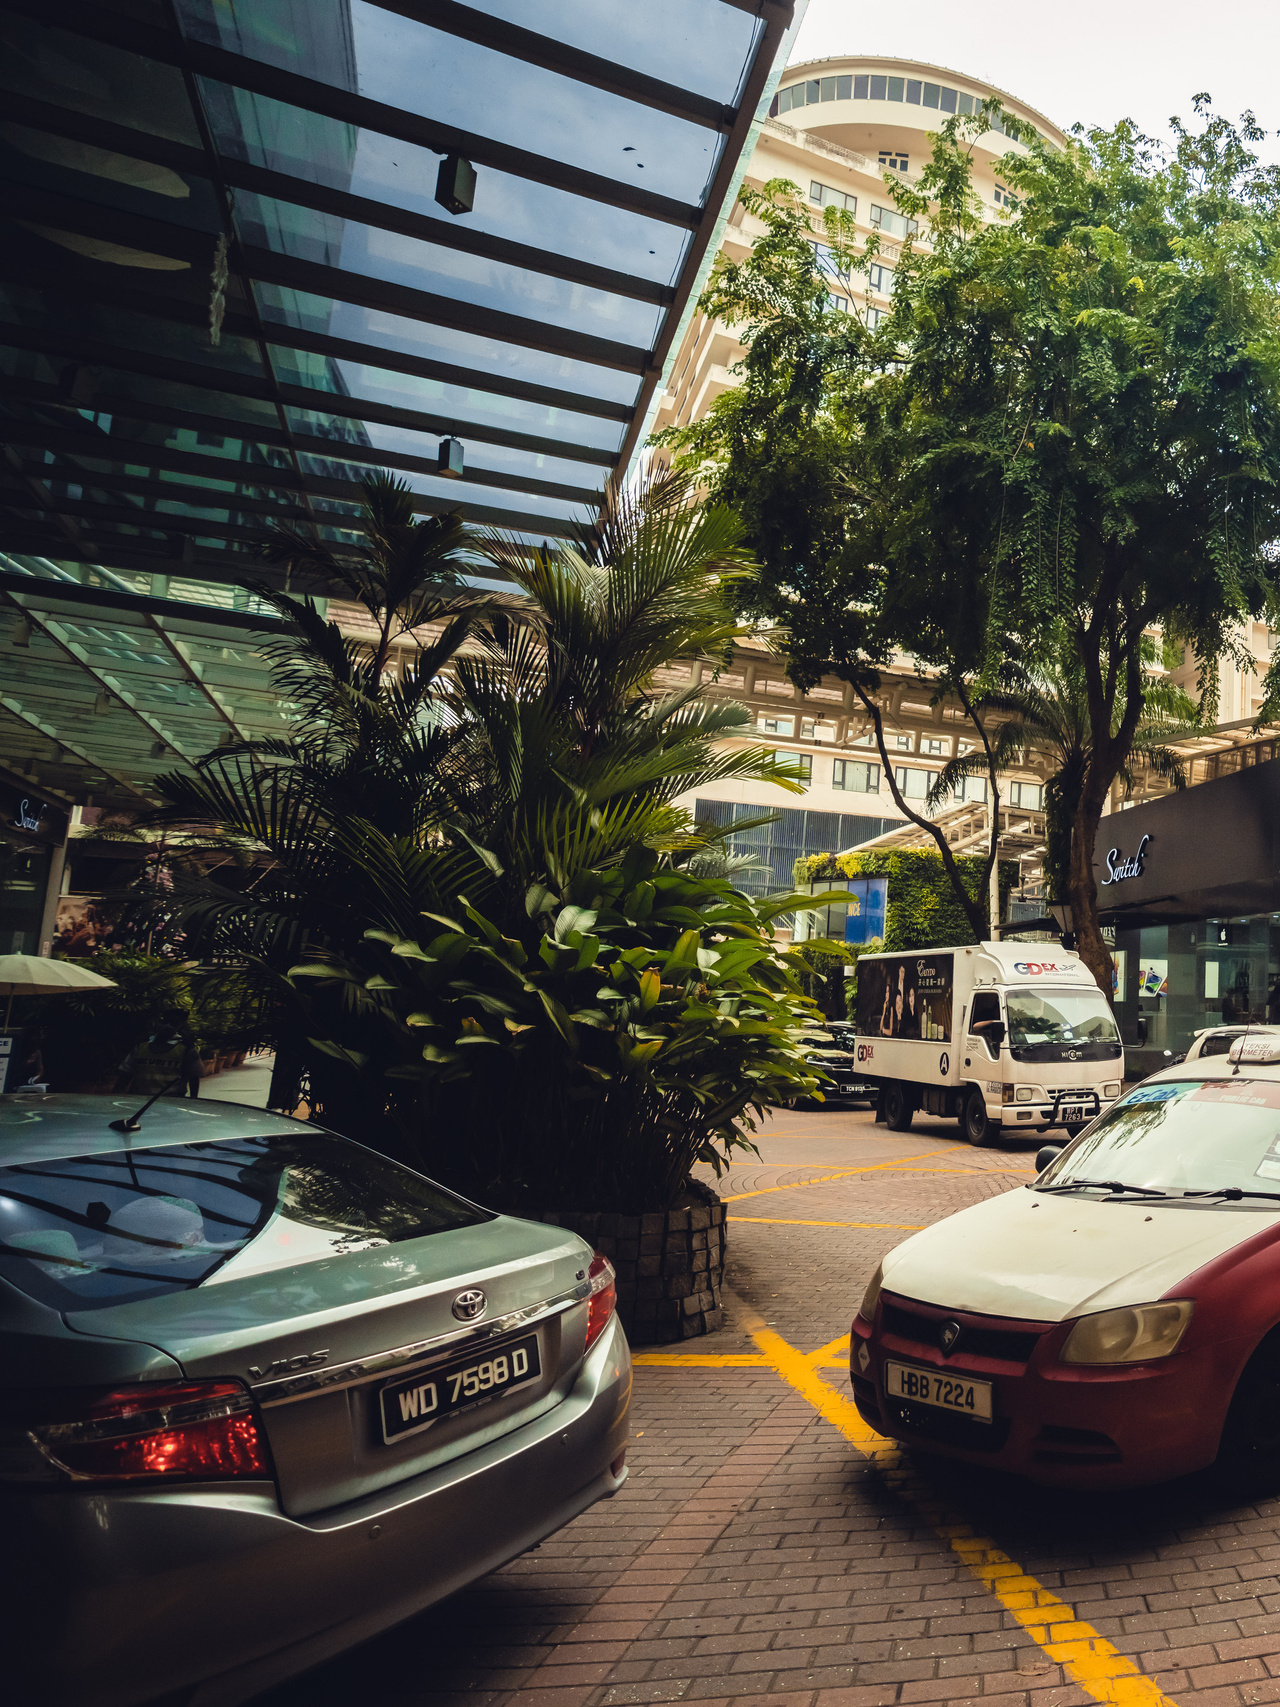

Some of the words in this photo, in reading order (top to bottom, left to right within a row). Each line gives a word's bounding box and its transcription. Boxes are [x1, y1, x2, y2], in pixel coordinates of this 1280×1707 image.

[1101, 834, 1150, 885] Switch
[1232, 1049, 1274, 1057] BERMETER
[398, 1382, 438, 1422] WD
[446, 1355, 510, 1403] 7598
[512, 1348, 529, 1377] D
[901, 1370, 930, 1399] HBB
[933, 1378, 975, 1410] 7224
